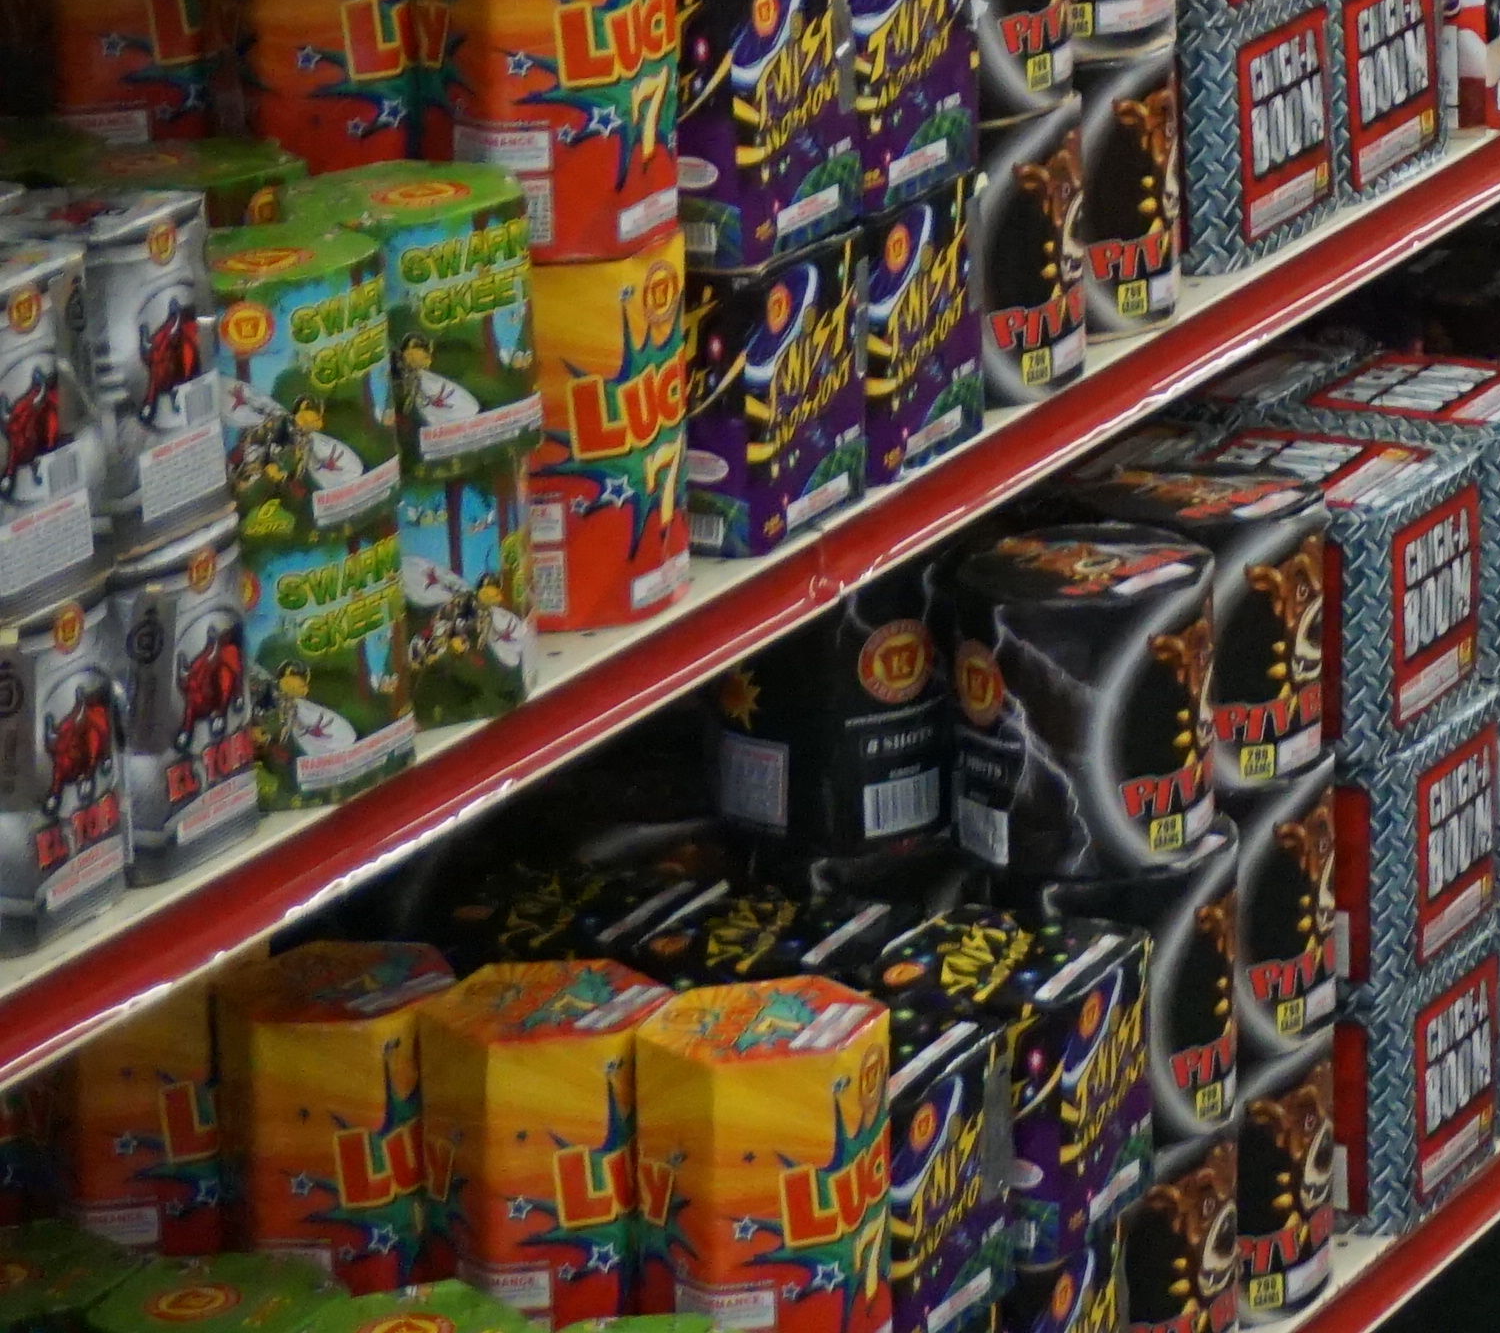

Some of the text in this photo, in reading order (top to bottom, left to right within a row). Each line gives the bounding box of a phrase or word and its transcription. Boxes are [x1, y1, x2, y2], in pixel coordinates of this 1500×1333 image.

[630, 66, 672, 163] 7
[889, 233, 968, 349] TWIST
[1086, 233, 1166, 281] PIT
[855, 1204, 889, 1305] 7
